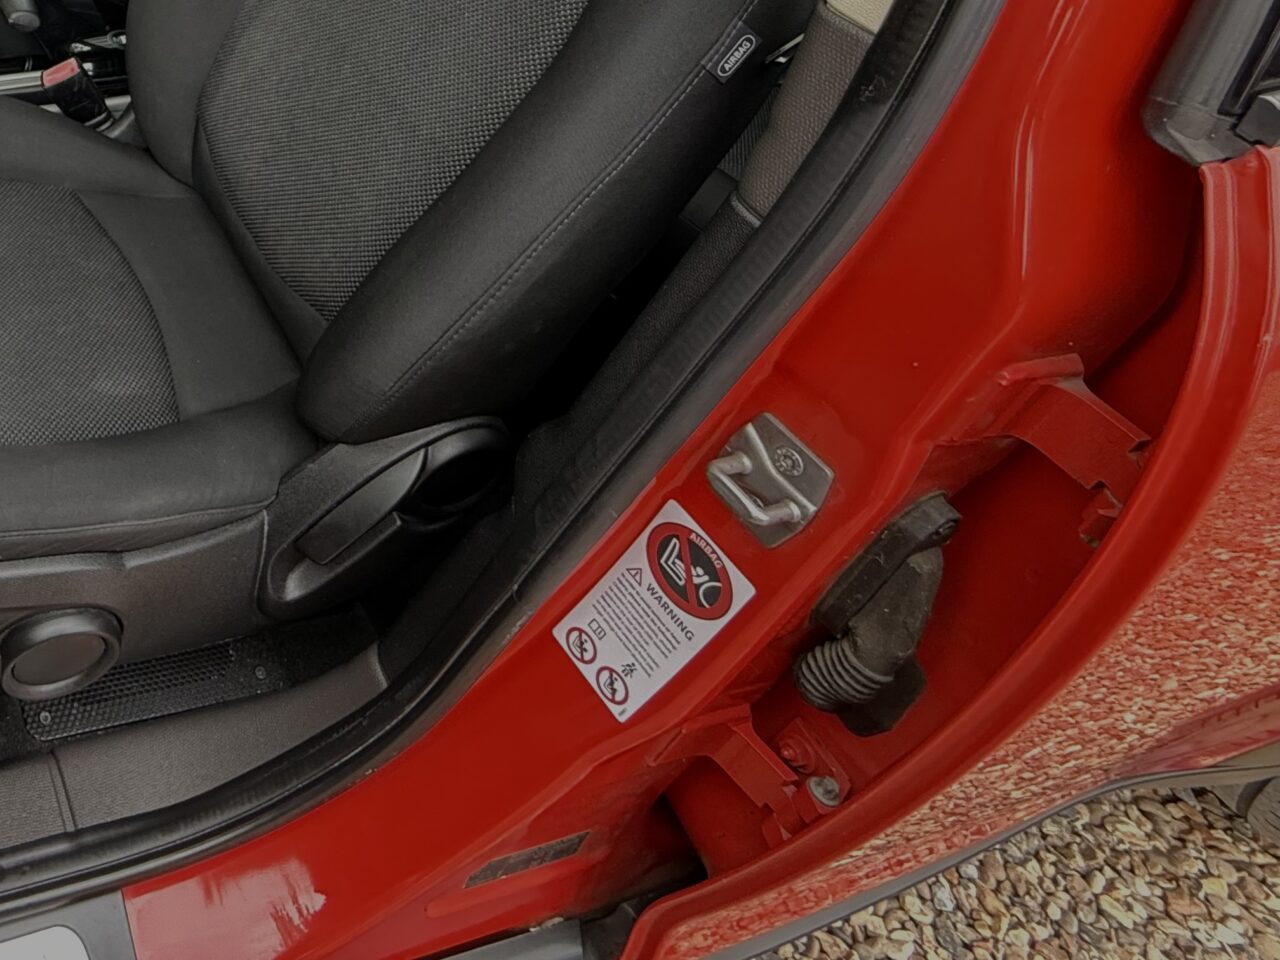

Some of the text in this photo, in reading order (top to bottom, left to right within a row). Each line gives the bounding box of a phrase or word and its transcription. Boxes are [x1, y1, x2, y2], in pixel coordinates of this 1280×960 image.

[723, 40, 751, 71] AIRBAG
[689, 532, 724, 569] AIRBAG
[646, 583, 696, 641] WARNING
